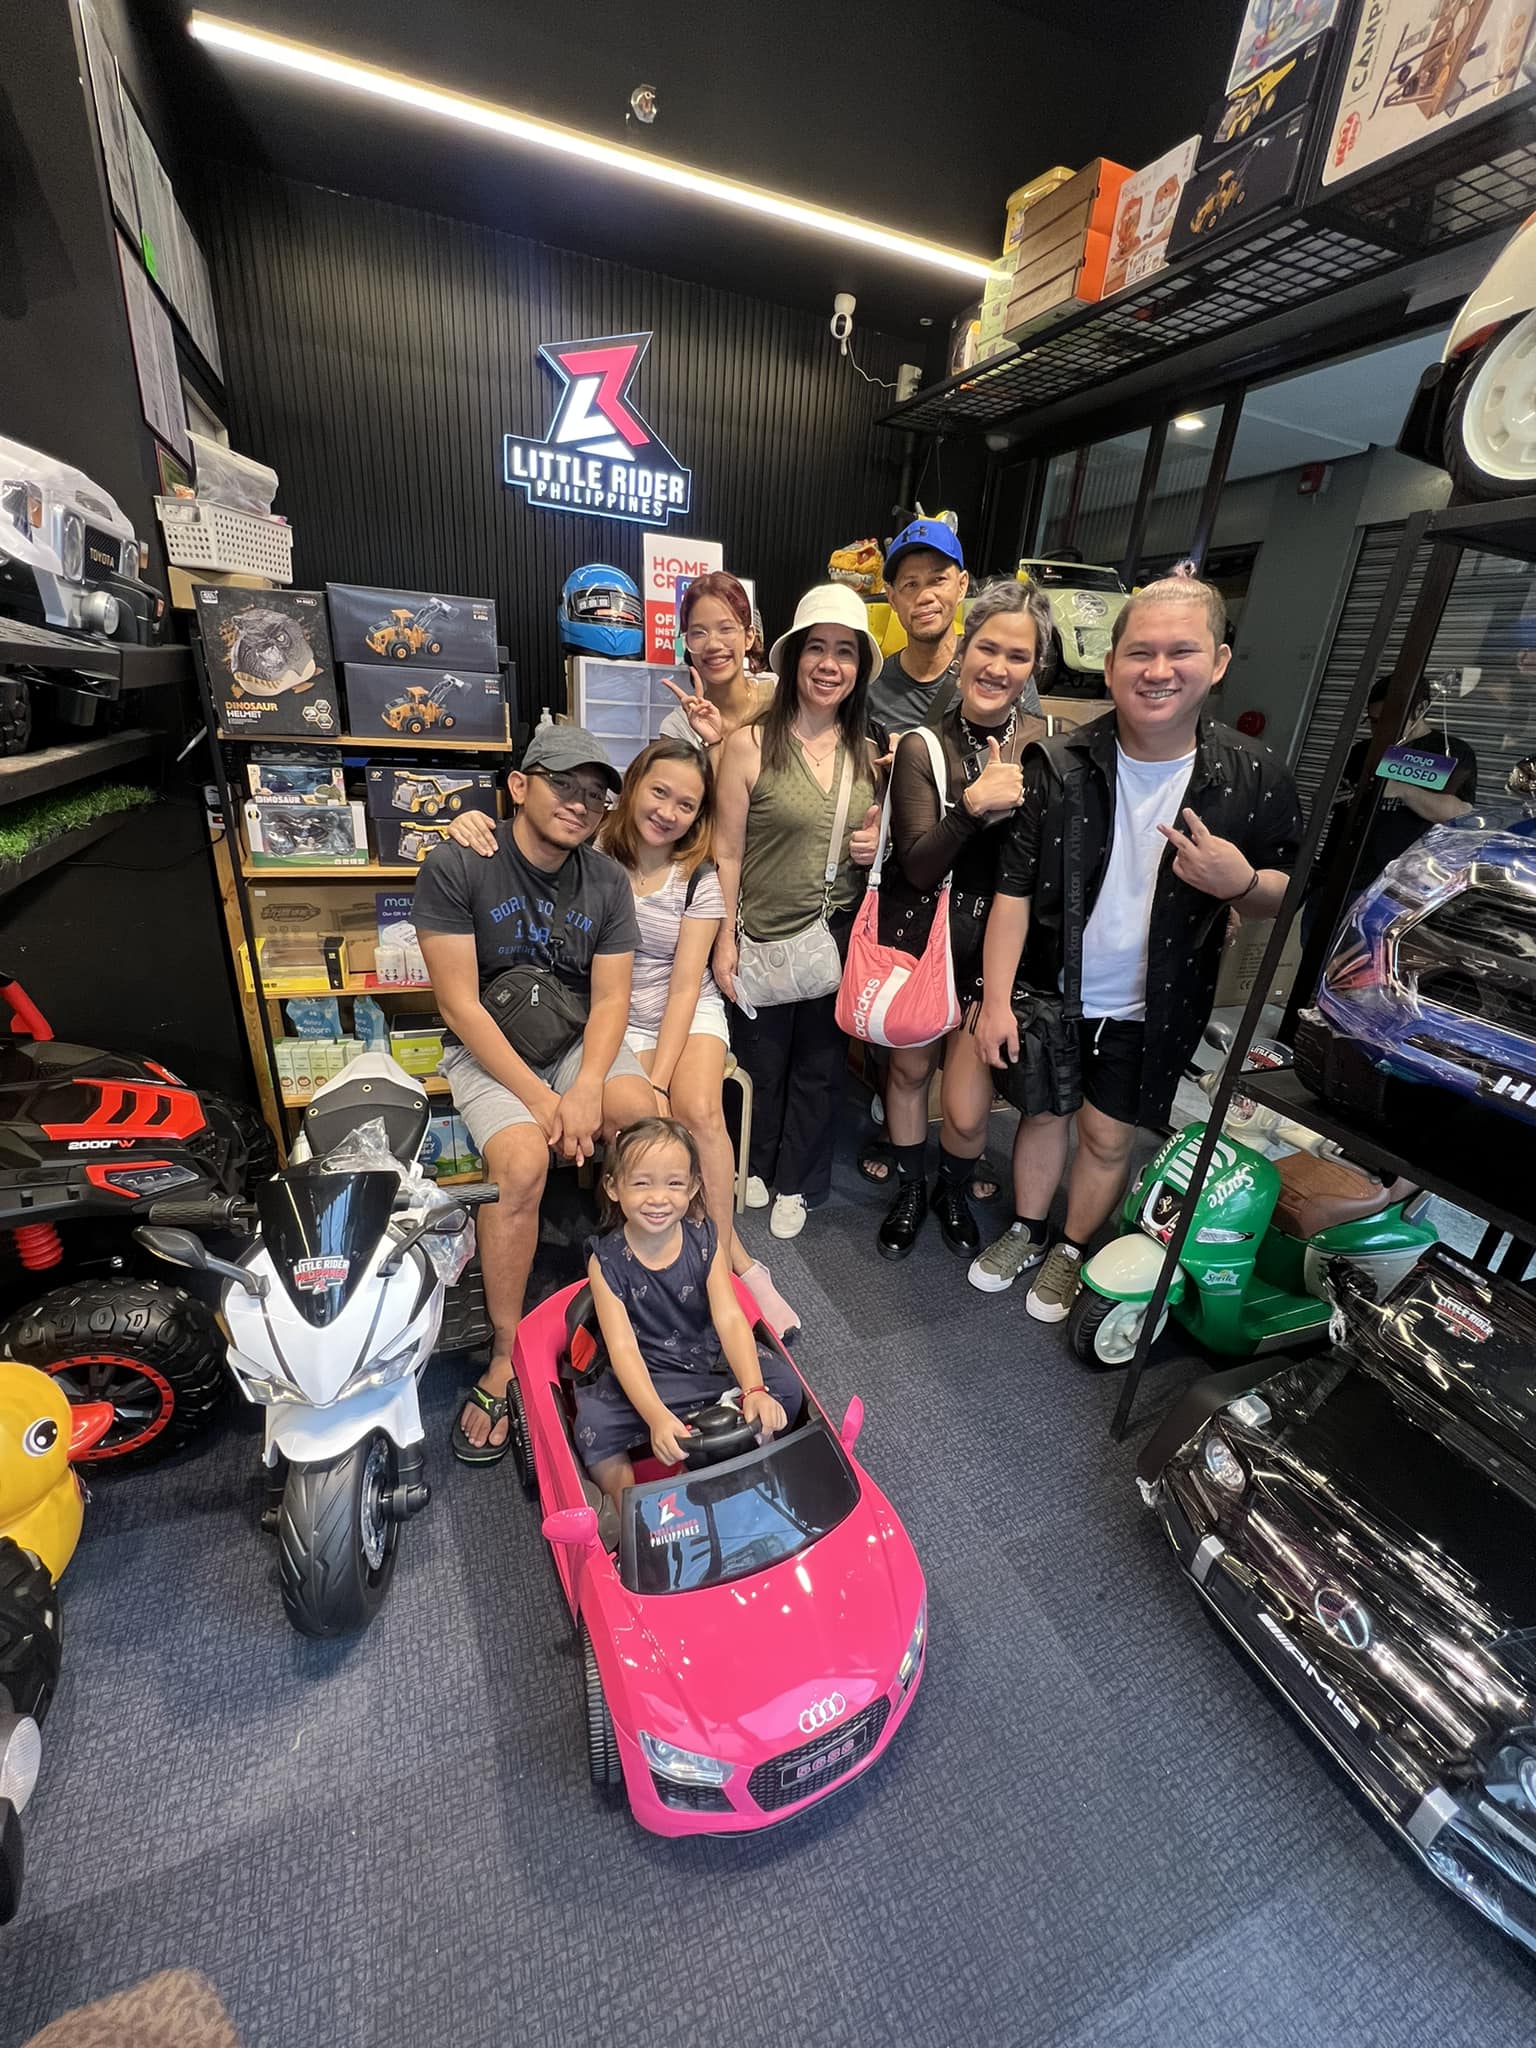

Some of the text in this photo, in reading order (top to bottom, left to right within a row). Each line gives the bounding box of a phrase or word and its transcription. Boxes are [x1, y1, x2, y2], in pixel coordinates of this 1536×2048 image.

[1350, 0, 1384, 92] CAMP
[512, 446, 685, 504] LITTLE RIDER
[536, 479, 663, 517] PHILIPPINES
[89, 547, 115, 568] TOYOTA
[653, 556, 709, 578] HOME
[653, 573, 676, 589] CR
[655, 627, 676, 636] INST
[225, 701, 278, 712] DINOSAUR
[226, 710, 262, 719] HELMET
[1403, 753, 1434, 767] maya
[1387, 763, 1438, 783] CLOSED
[255, 795, 300, 804] DINOSAUR
[536, 898, 554, 916] TO
[853, 977, 881, 1037] adidas
[1153, 1130, 1187, 1170] Sprite
[1207, 1165, 1256, 1209] Sprite
[293, 1259, 350, 1274] LITTLE RIDER
[650, 1524, 700, 1548] PHILIPPINES
